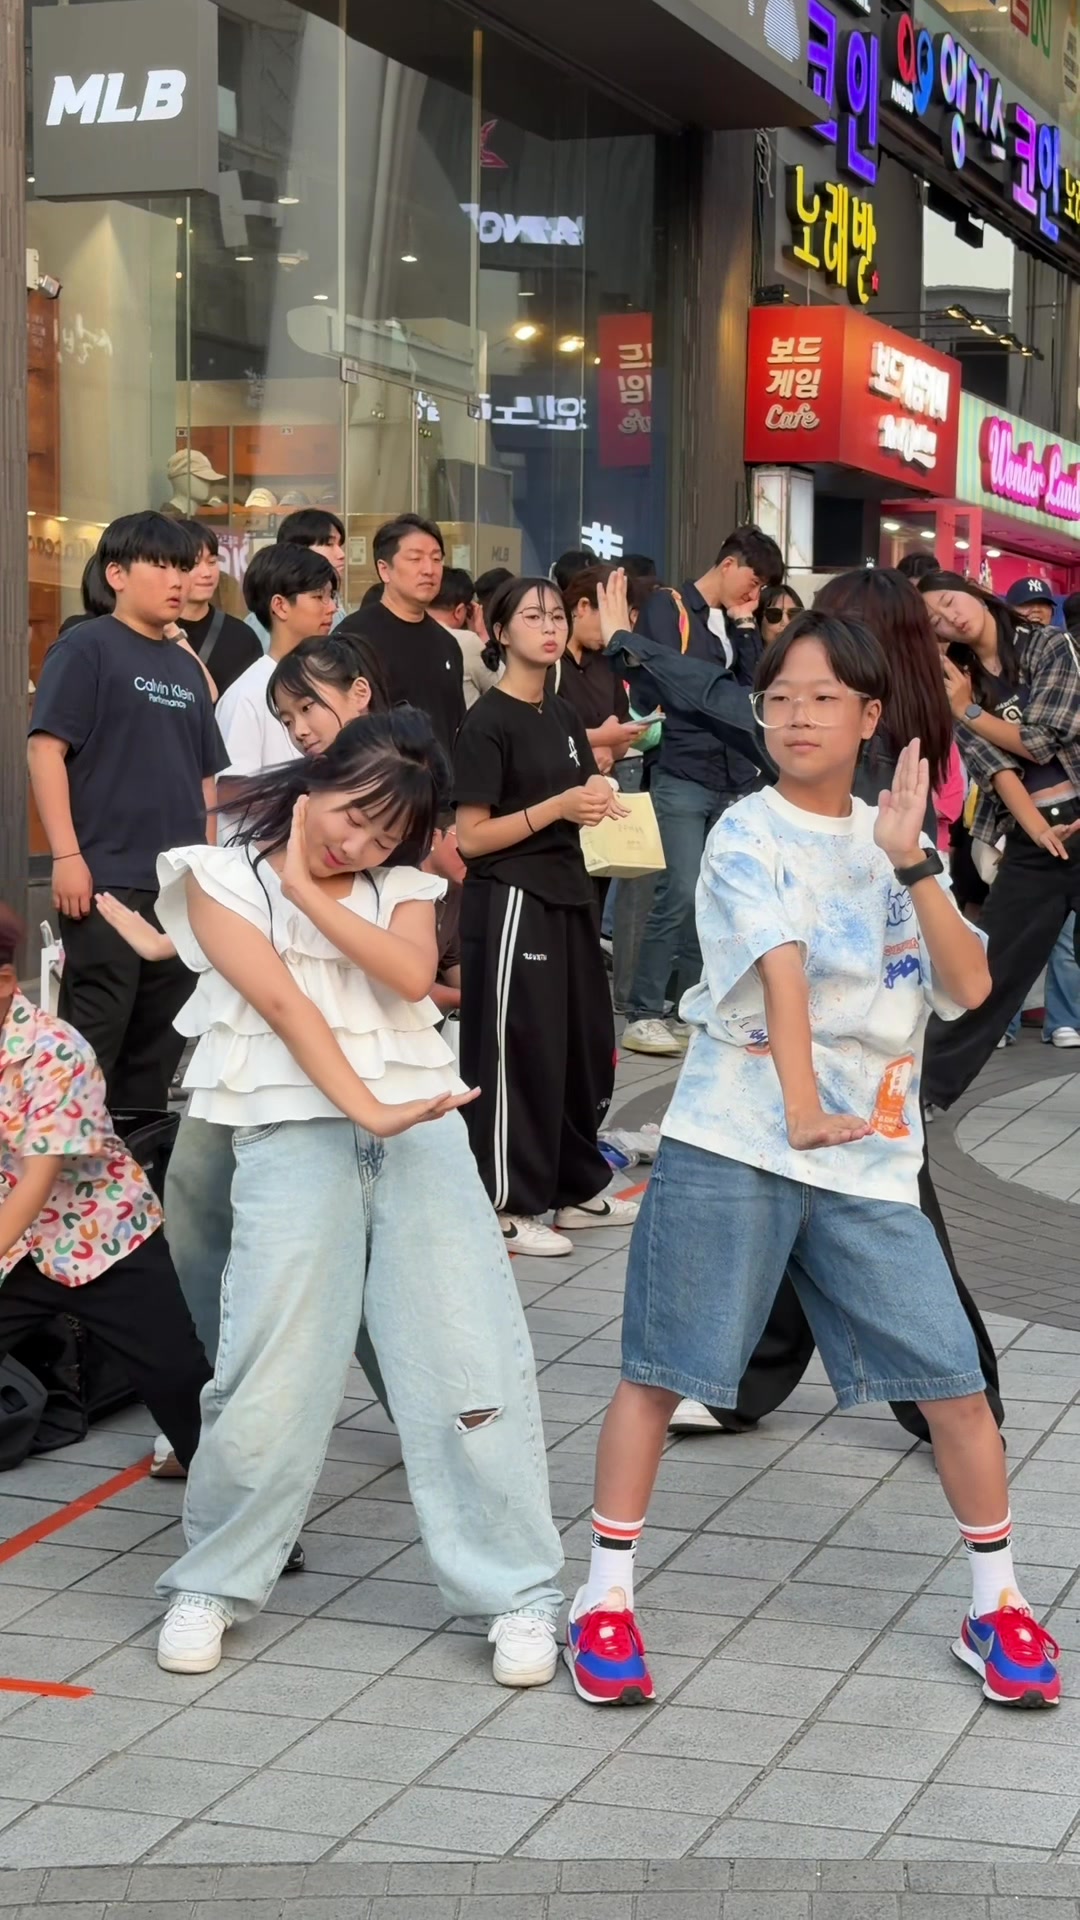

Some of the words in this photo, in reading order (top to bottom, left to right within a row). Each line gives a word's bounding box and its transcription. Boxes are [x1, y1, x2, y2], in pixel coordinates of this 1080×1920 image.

[46, 69, 187, 126] MLB
[941, 33, 1007, 170] 앵거스
[1013, 104, 1060, 243] 코인
[1064, 167, 1080, 224] 노
[793, 165, 877, 304] 노래방
[766, 337, 822, 364] 보드
[765, 368, 822, 399] 게임
[765, 402, 821, 430] Cafe
[988, 418, 1047, 504] Wonder
[1044, 446, 1080, 517] Land
[491, 545, 510, 562] MLB
[1027, 579, 1043, 592] NY
[133, 676, 170, 696] Calvin
[170, 683, 196, 703] Klein
[148, 693, 187, 710] Performance
